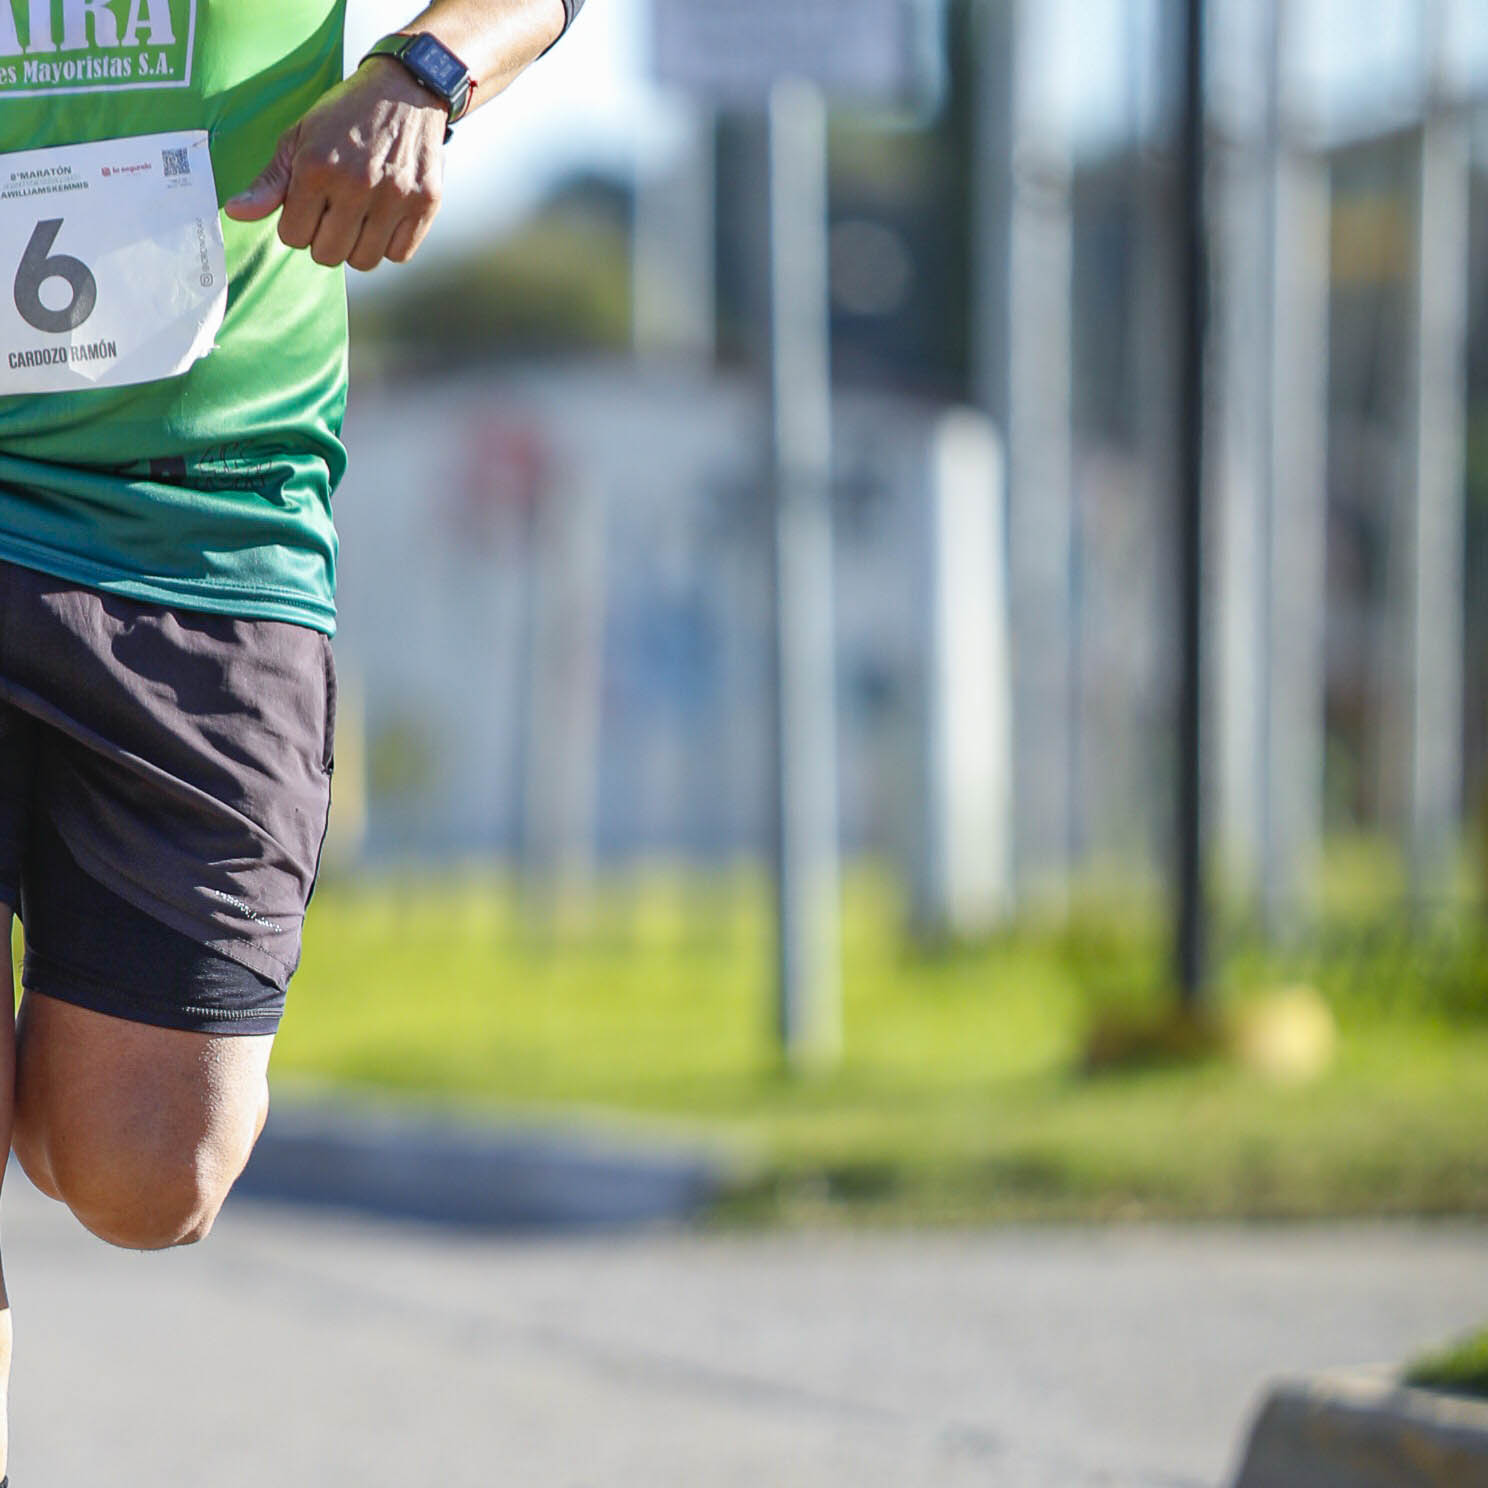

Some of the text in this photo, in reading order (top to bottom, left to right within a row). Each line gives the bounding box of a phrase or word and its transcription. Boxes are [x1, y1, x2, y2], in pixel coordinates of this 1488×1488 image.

[23, 55, 132, 84] Mayoristas
[138, 52, 175, 76] S.A.
[13, 218, 97, 333] 6
[8, 338, 117, 369] CARDOZO RAMÓN
